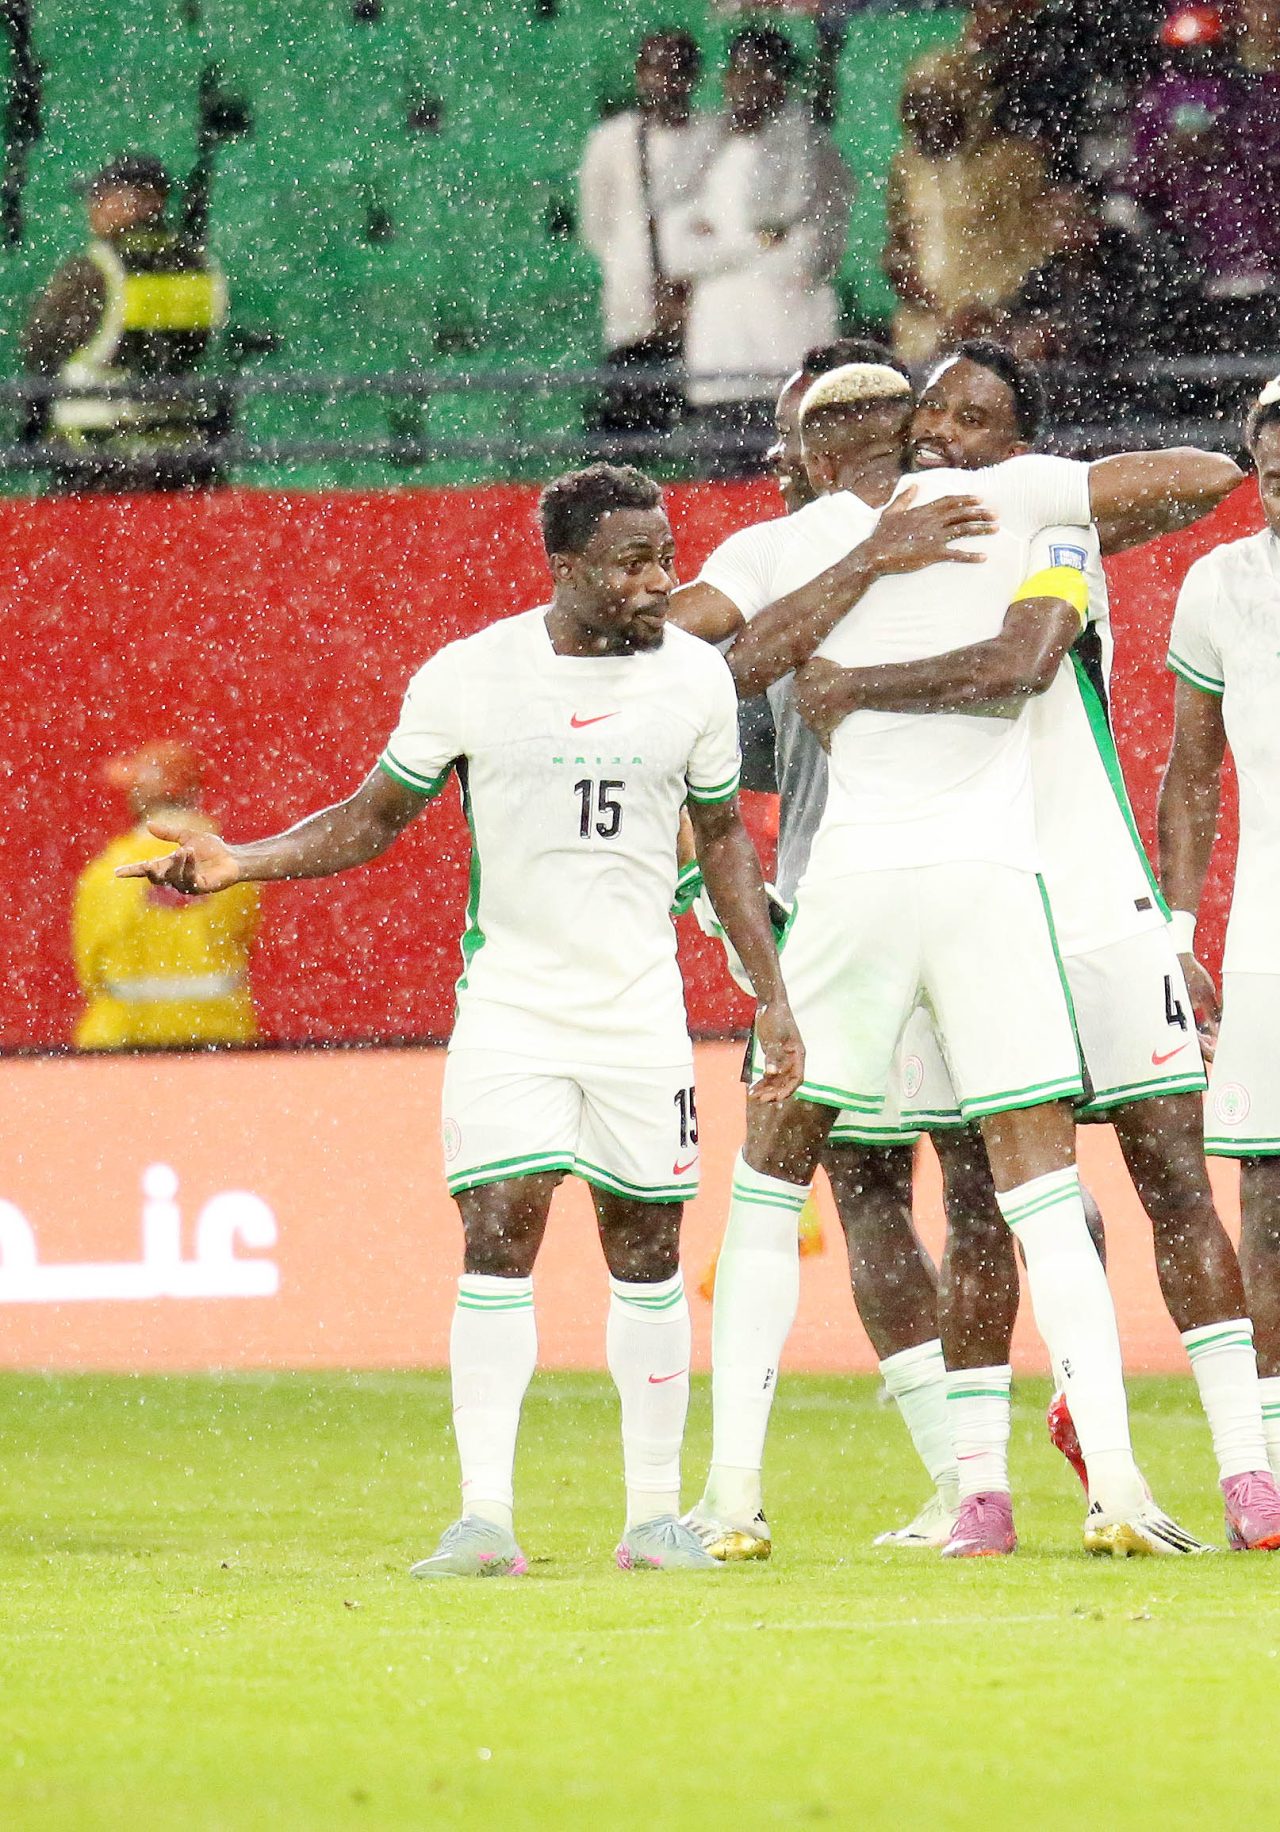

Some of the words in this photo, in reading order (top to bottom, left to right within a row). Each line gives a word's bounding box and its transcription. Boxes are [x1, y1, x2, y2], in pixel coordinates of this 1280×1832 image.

[552, 756, 643, 765] NAIJA
[574, 779, 626, 841] 15
[1164, 975, 1188, 1032] 4
[674, 1086, 699, 1149] 15
